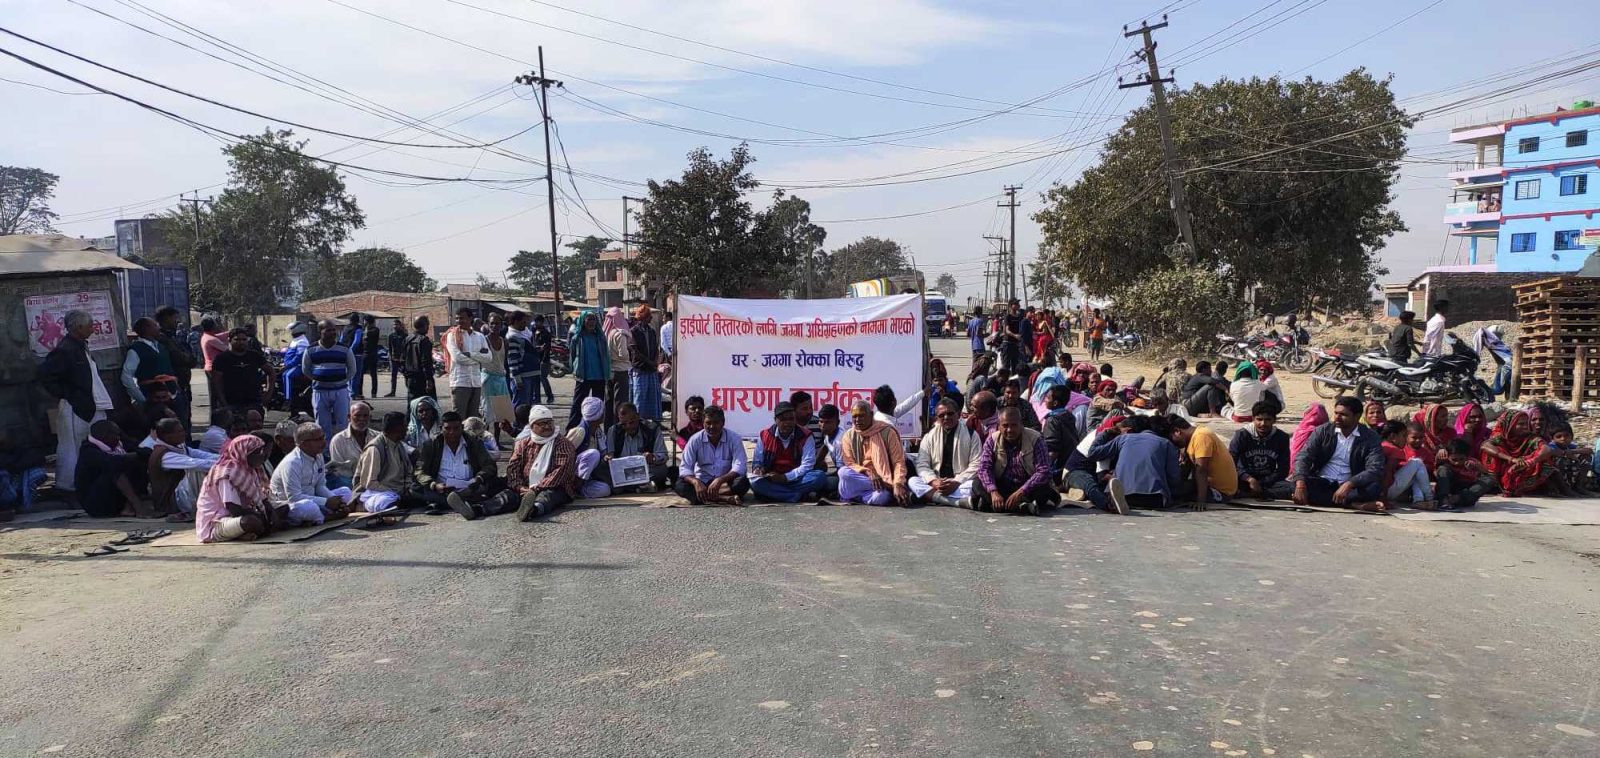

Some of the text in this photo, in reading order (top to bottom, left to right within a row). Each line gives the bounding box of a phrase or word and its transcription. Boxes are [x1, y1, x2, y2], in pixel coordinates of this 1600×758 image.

[713, 312, 753, 337] विस्तारको
[755, 317, 778, 336] लागि
[780, 322, 803, 338] जग्गा
[860, 319, 888, 335] नाममा
[890, 312, 915, 336] भएको
[731, 354, 750, 368] घर
[761, 353, 792, 368] जग्गा
[795, 348, 831, 368] रोक्का
[711, 381, 877, 416] धारणा ार्यक्र
